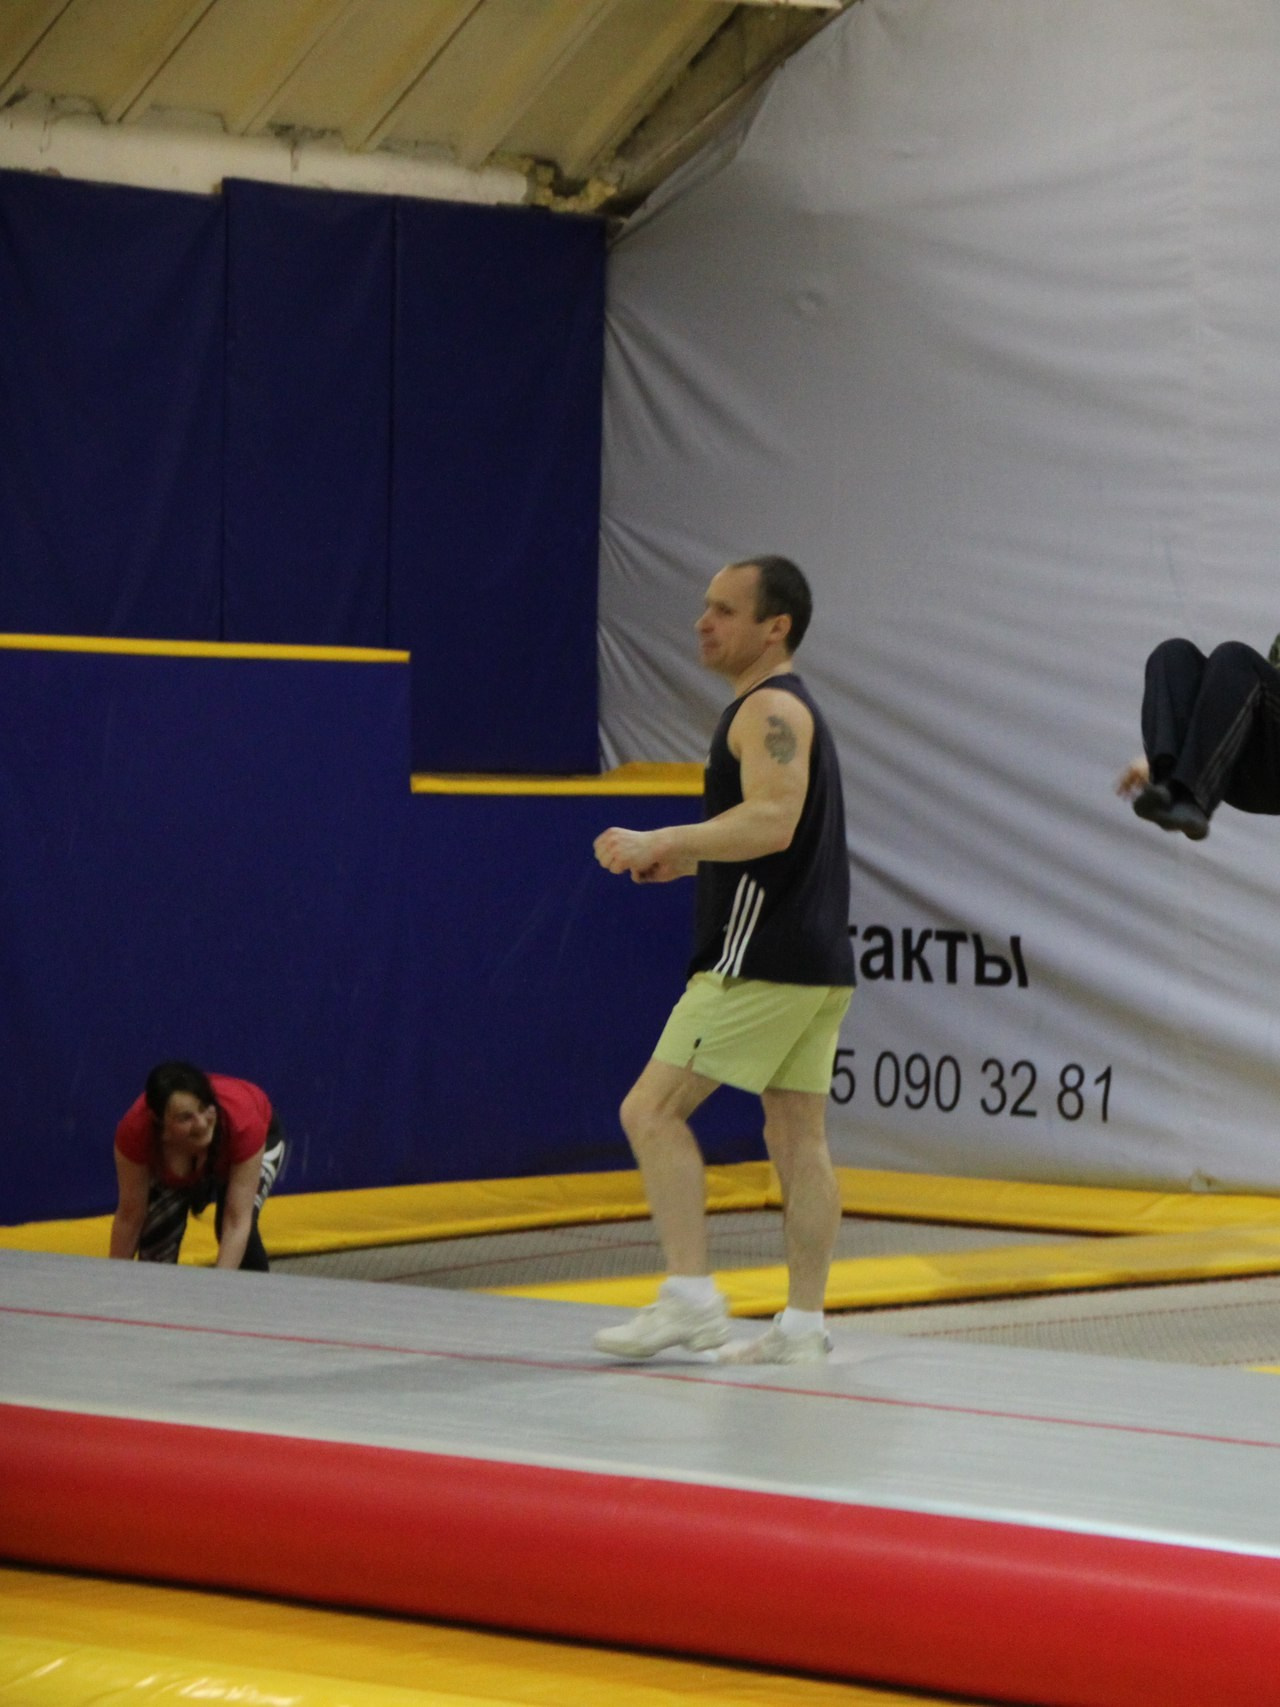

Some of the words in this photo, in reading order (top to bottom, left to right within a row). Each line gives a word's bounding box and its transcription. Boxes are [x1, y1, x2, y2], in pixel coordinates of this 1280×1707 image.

[848, 923, 1029, 988] акты
[830, 1048, 856, 1104] 5
[873, 1050, 962, 1113] 090
[980, 1058, 1037, 1118] 32
[1056, 1063, 1113, 1123] 81
